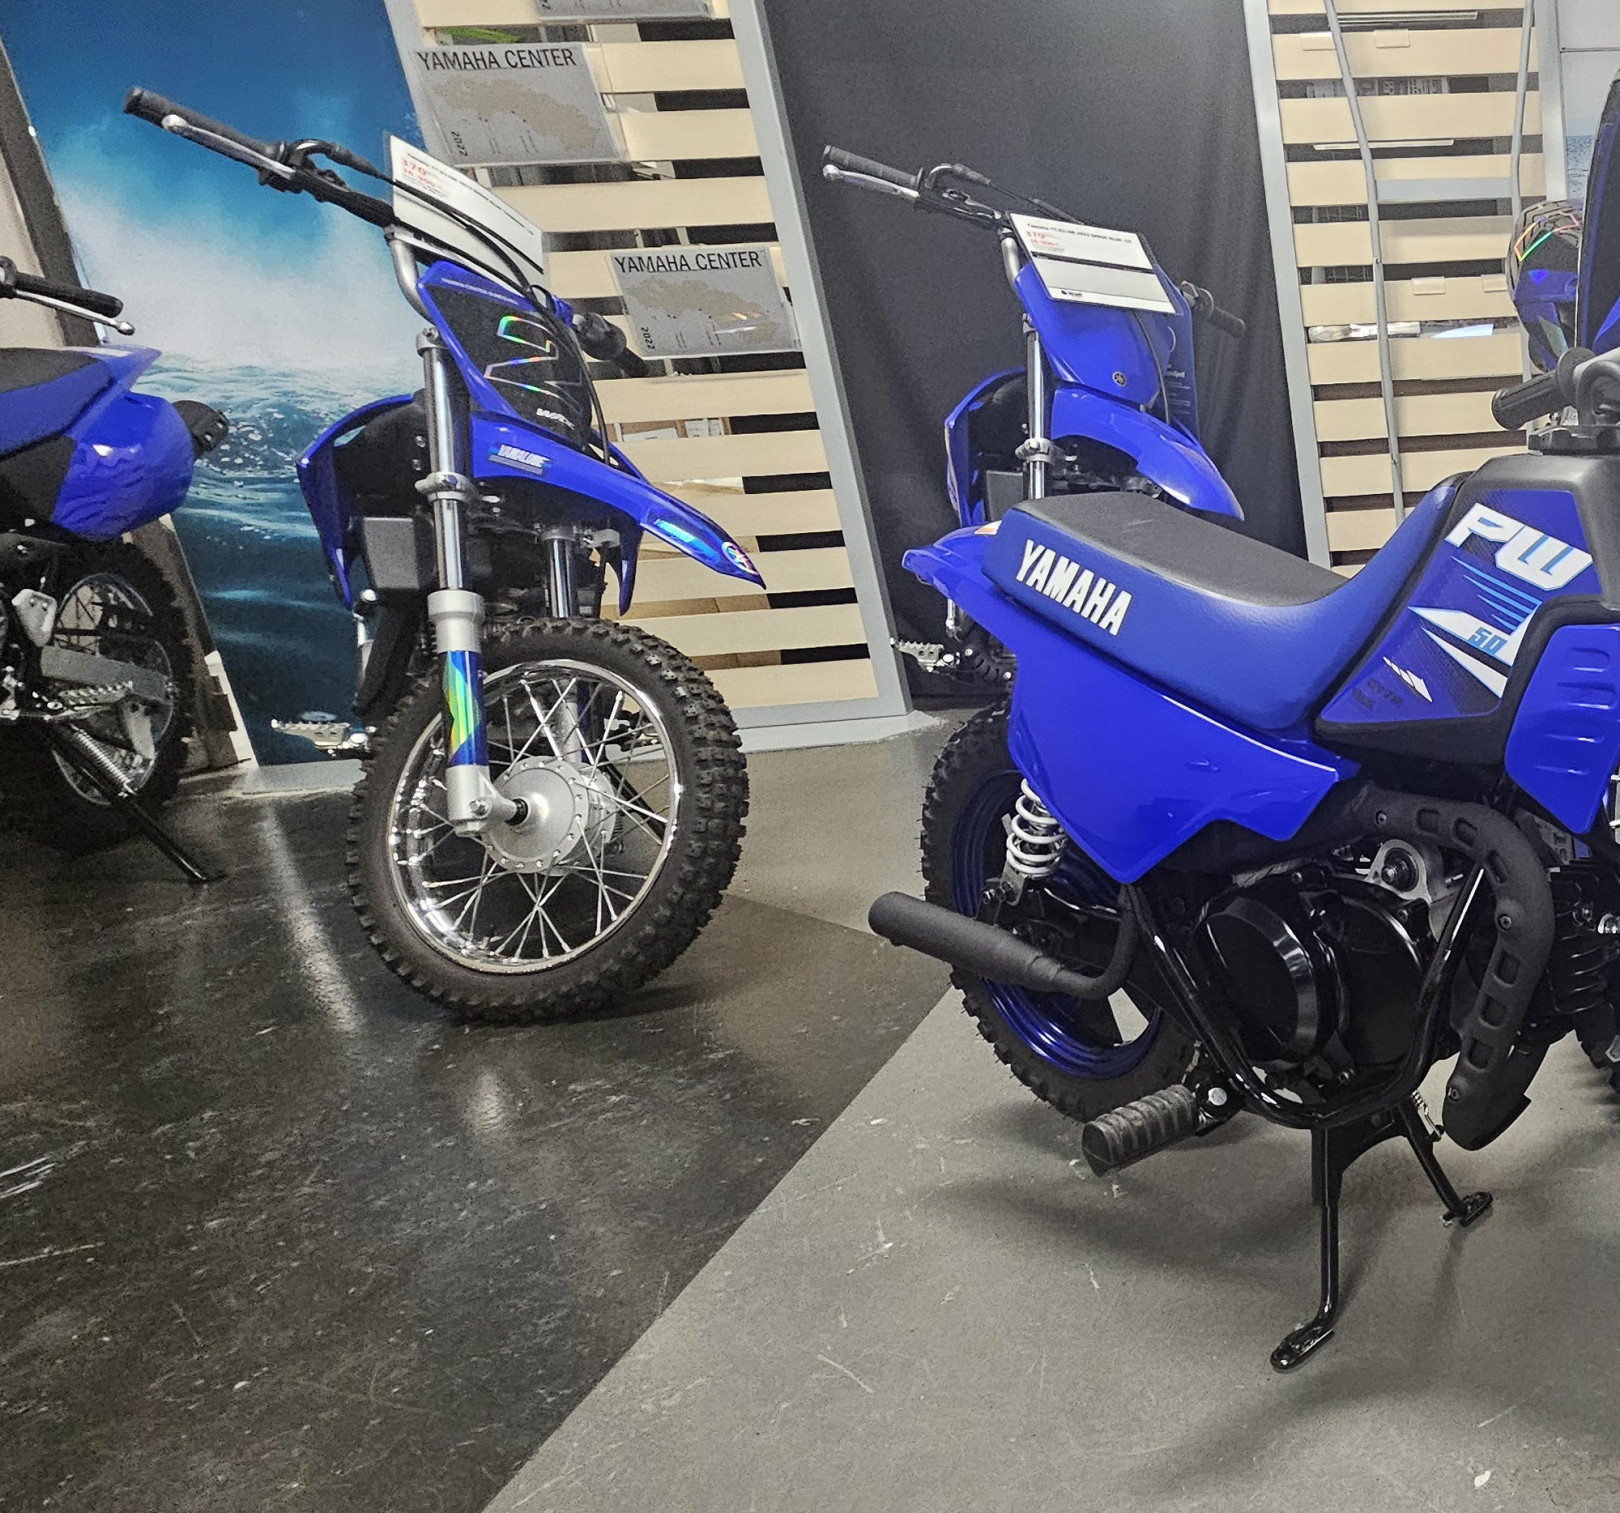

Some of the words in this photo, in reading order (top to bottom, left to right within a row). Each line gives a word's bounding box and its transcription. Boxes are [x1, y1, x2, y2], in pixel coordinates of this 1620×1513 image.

[417, 51, 501, 71] YAMAHA
[504, 48, 577, 69] CENTER
[614, 254, 691, 274] YAMAHA
[695, 250, 763, 270] CENTER
[640, 326, 656, 351] 2022
[1444, 502, 1594, 591] PW
[1015, 538, 1133, 637] YAMAHA
[1469, 626, 1508, 656] 50
